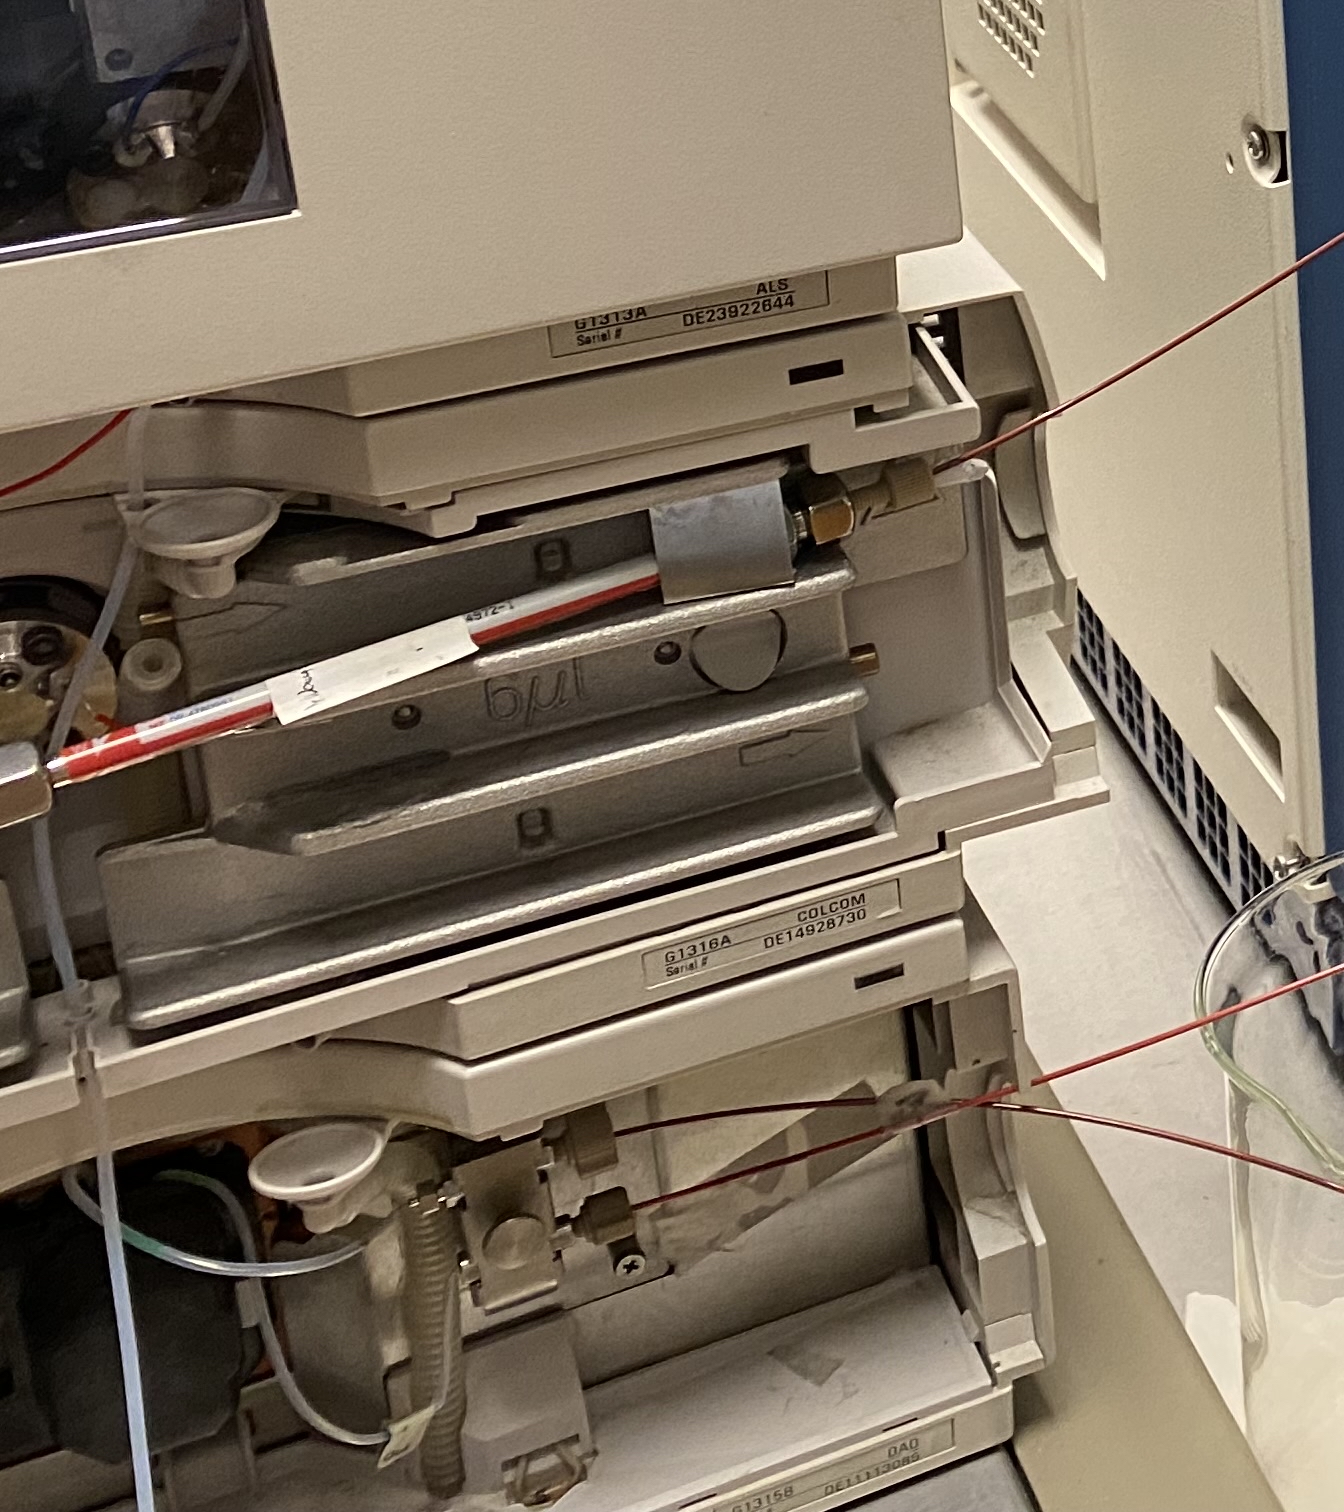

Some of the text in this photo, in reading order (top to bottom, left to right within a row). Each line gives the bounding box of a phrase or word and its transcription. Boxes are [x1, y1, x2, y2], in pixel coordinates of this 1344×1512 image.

[756, 278, 789, 295] ALS
[577, 329, 611, 346] Serial
[665, 893, 867, 963] G1316A COLCOM
[666, 960, 698, 977] Serial
[764, 908, 867, 949] DE14928730
